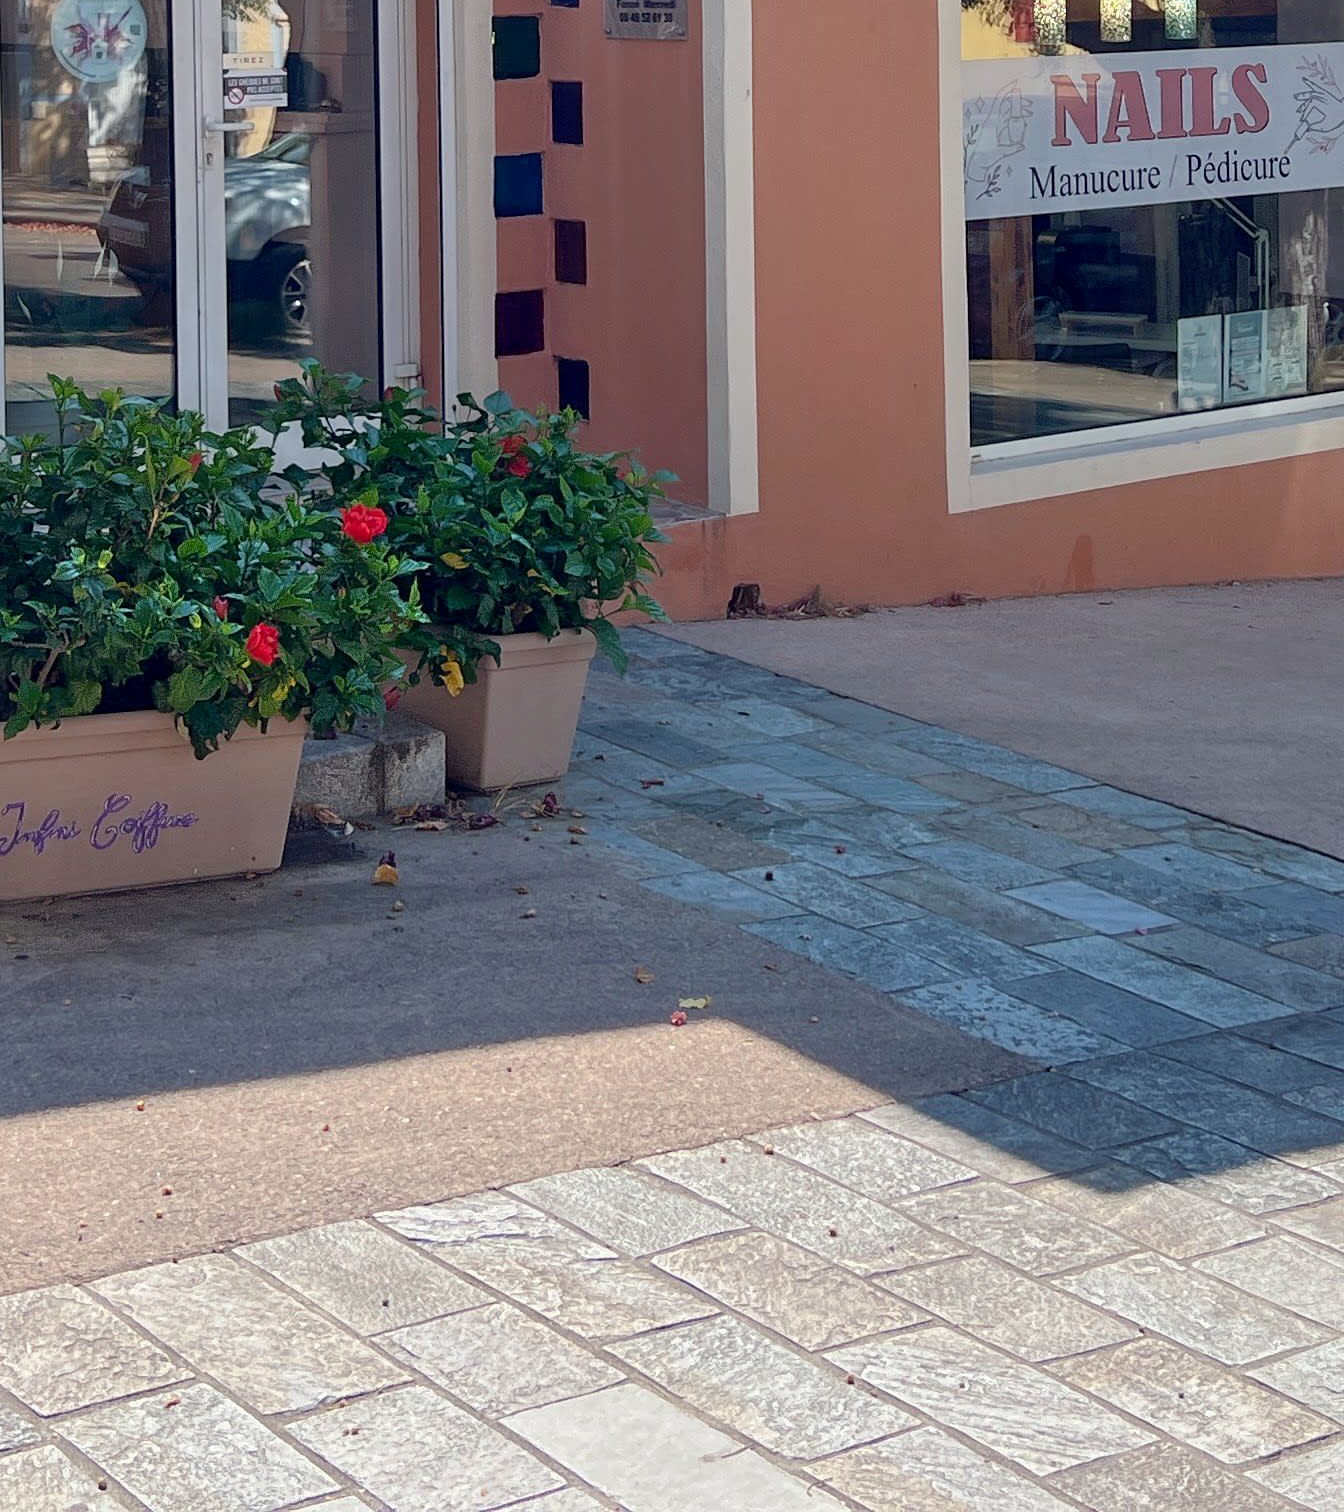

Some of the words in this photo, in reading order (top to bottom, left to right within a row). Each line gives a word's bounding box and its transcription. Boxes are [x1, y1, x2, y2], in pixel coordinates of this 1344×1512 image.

[232, 56, 265, 65] TIREZ
[1050, 63, 1270, 147] NAILS
[1029, 163, 1161, 200] Manucure
[1185, 149, 1292, 187] Pédicure
